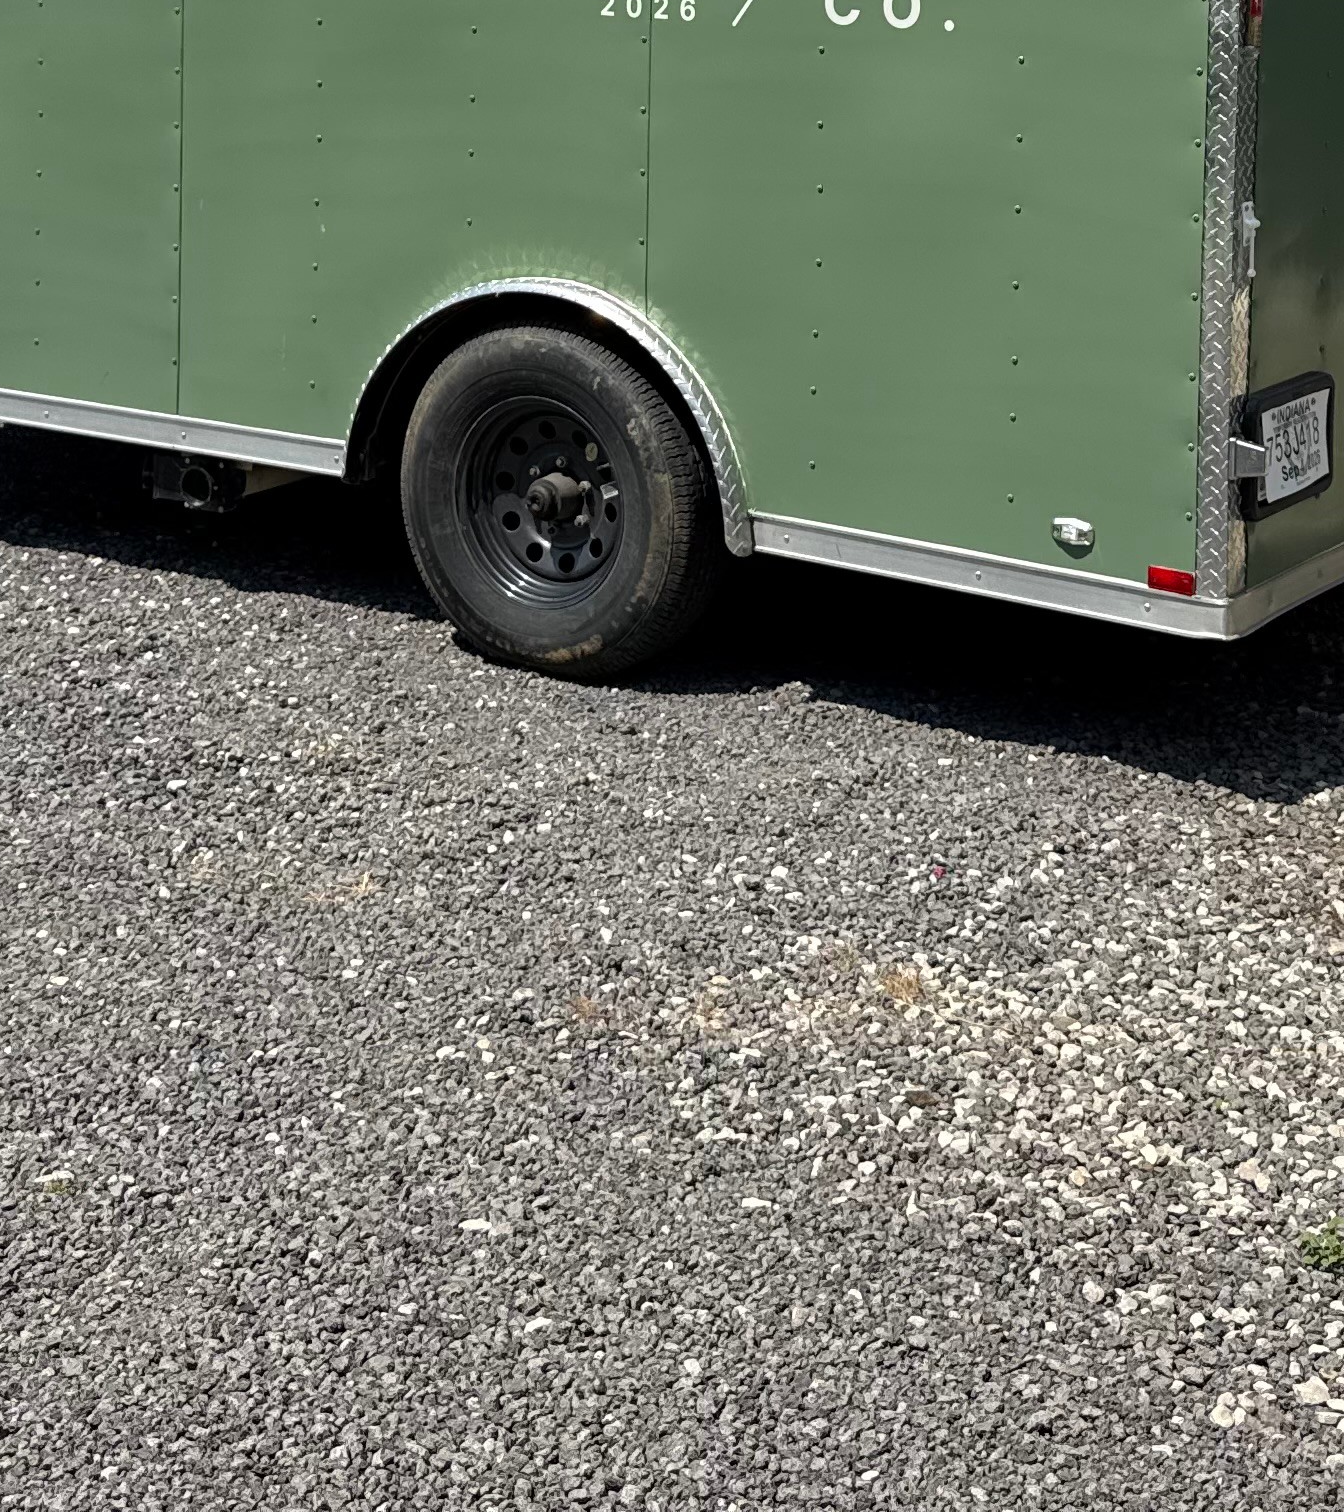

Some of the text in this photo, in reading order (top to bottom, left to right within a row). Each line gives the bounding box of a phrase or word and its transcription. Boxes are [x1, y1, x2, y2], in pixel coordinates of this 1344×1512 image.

[1276, 397, 1311, 424] INDIANA
[1265, 416, 1320, 467] 753J418
[1282, 464, 1300, 482] Sep
